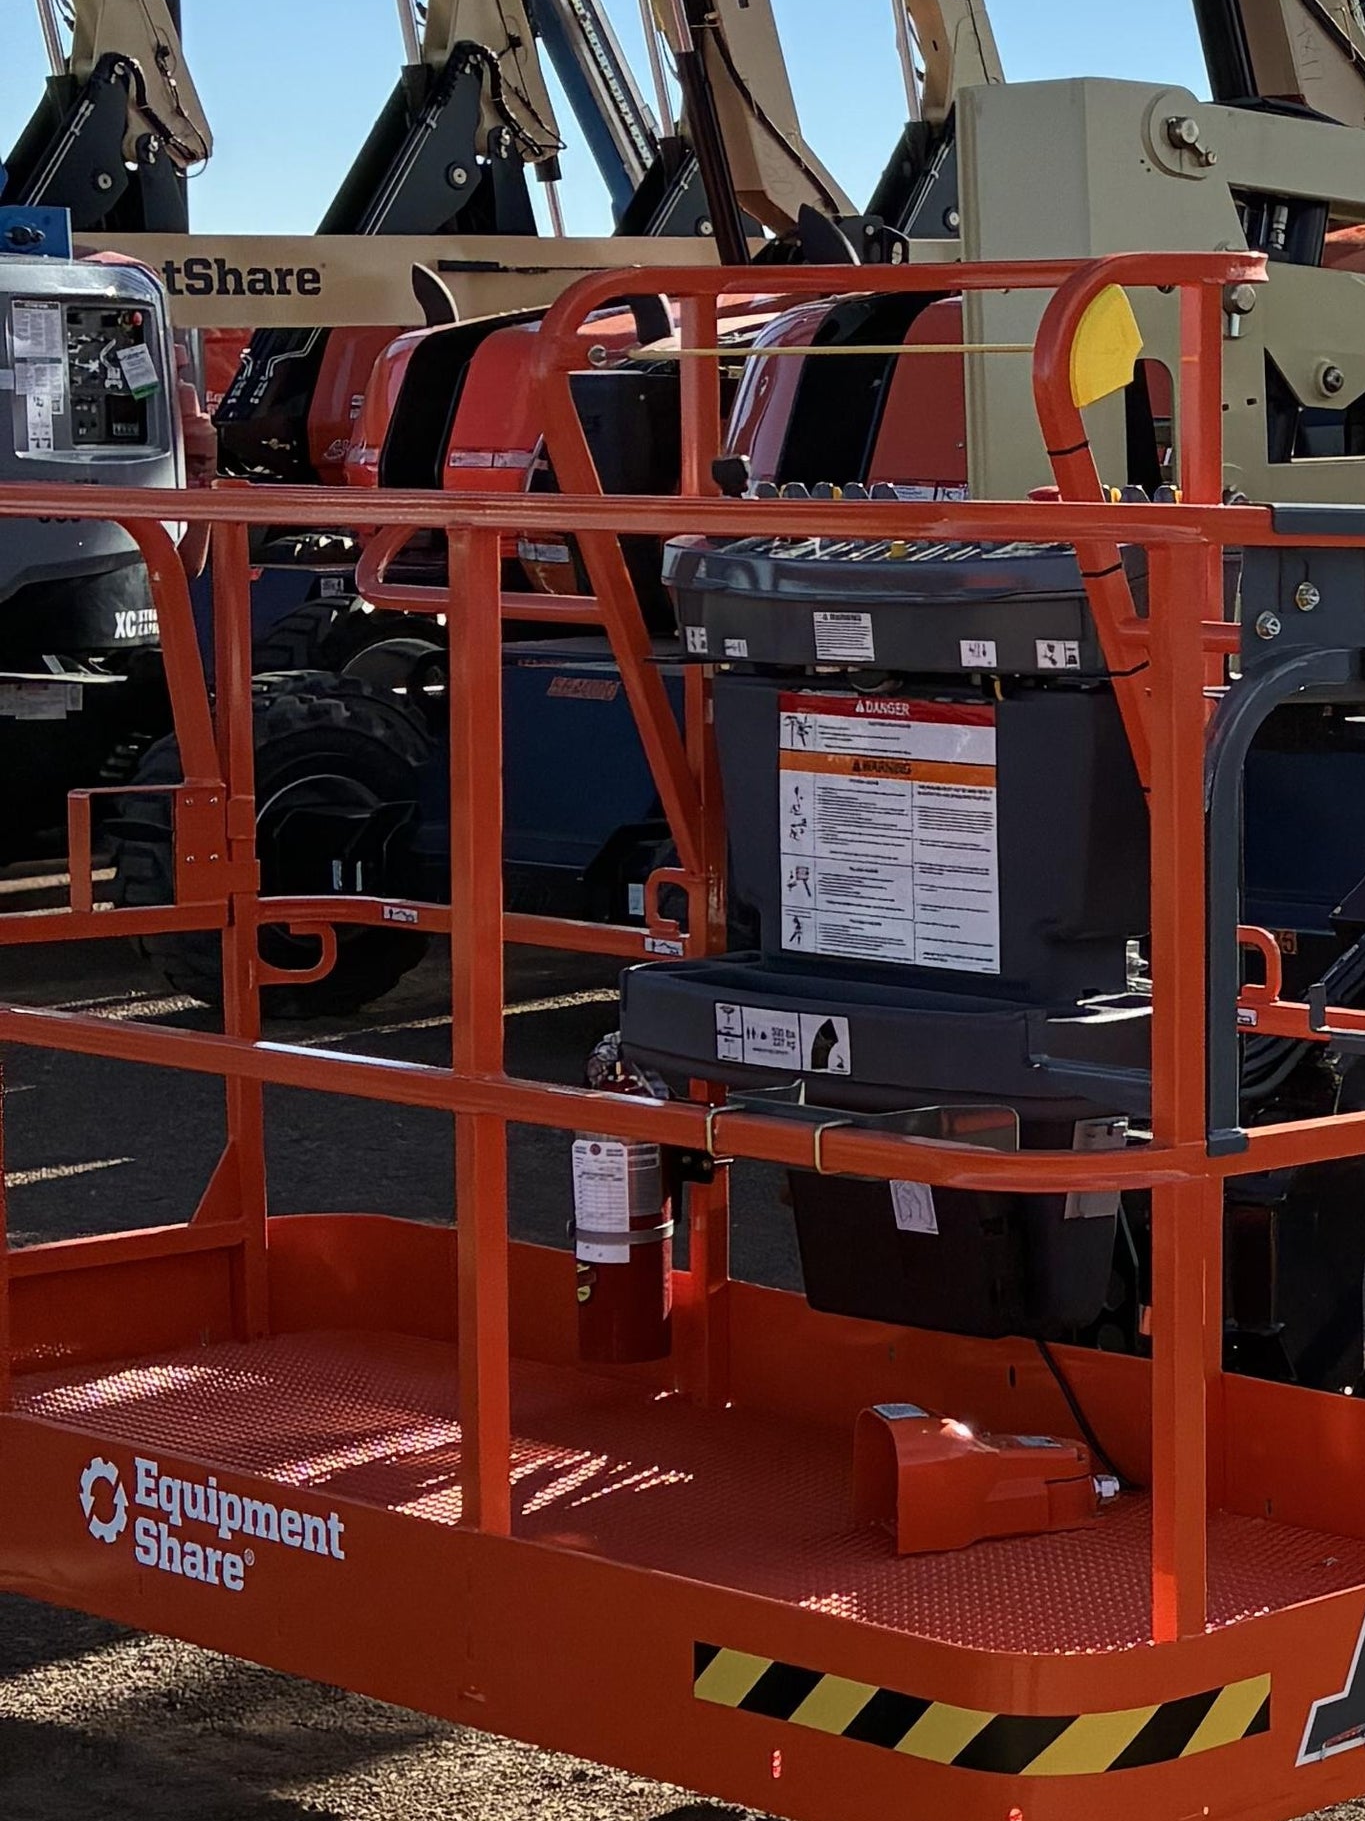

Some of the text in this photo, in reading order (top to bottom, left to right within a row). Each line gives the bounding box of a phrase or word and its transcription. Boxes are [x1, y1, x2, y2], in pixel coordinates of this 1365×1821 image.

[113, 610, 137, 639] XC
[866, 701, 911, 717] DANGER
[134, 1456, 345, 1560] Equipment
[134, 1515, 245, 1591] Share
